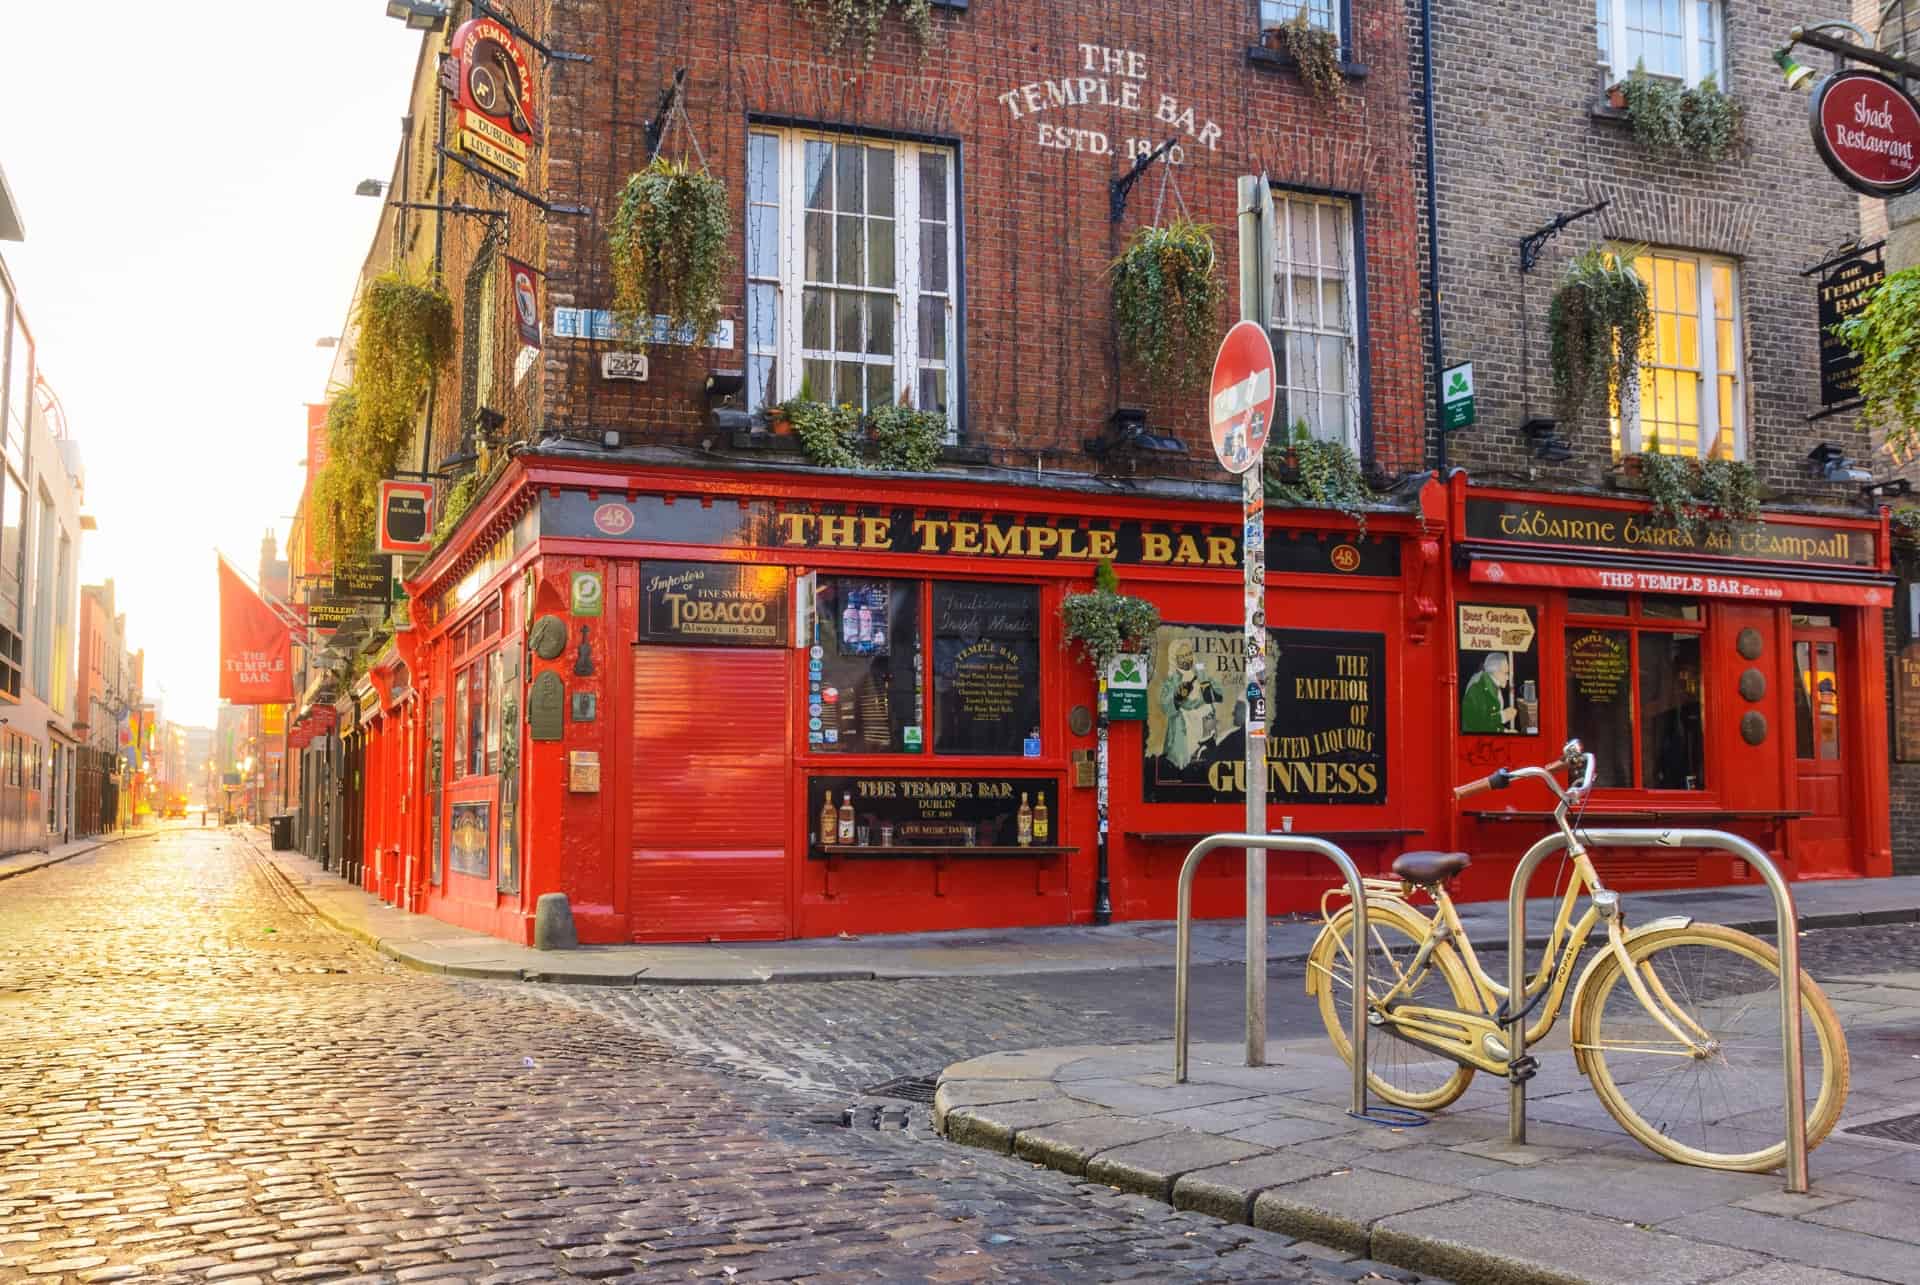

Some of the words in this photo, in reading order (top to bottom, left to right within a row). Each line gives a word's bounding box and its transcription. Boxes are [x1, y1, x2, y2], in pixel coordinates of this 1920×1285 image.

[463, 32, 477, 65] THE
[475, 24, 520, 60] TEMPLE
[518, 64, 531, 103] BAR
[1078, 43, 1148, 80] THE
[999, 77, 1142, 120] TEMPLE
[1154, 93, 1222, 151] BAR
[478, 119, 515, 149] DUBLIN
[1038, 123, 1115, 156] ESTD.
[1836, 124, 1914, 161] Restaurant
[470, 135, 491, 157] LIVE
[494, 150, 522, 173] MUSIC
[1841, 265, 1862, 280] THE
[1821, 271, 1885, 302] TEMPLE
[601, 508, 625, 527] 48
[780, 511, 893, 549] THE
[914, 519, 1119, 560] TEMPLE
[1141, 532, 1238, 567] BAR
[1336, 547, 1354, 567] 48
[646, 570, 705, 592] Importers
[1599, 572, 1634, 588] THE
[1637, 574, 1703, 592] TEMPLE
[1707, 578, 1740, 595] BAR
[698, 588, 720, 599] FINE
[662, 593, 767, 630] TOBACCO
[1486, 610, 1519, 624] Garden
[240, 651, 266, 662] THE
[1192, 637, 1273, 656] TEME
[225, 659, 285, 672] TEMPLE
[1336, 655, 1368, 677] THE
[240, 671, 272, 683] BAR
[1296, 678, 1368, 702] EMPEROR
[1350, 704, 1368, 726] OF
[1265, 735, 1310, 759] ALTED
[1313, 728, 1376, 755] LIQUORS
[1207, 760, 1378, 794] GUNNESS
[857, 780, 897, 798] THE
[901, 780, 974, 799] TEMPLE
[978, 782, 1014, 799] BAR
[918, 799, 957, 810] DUBLIN
